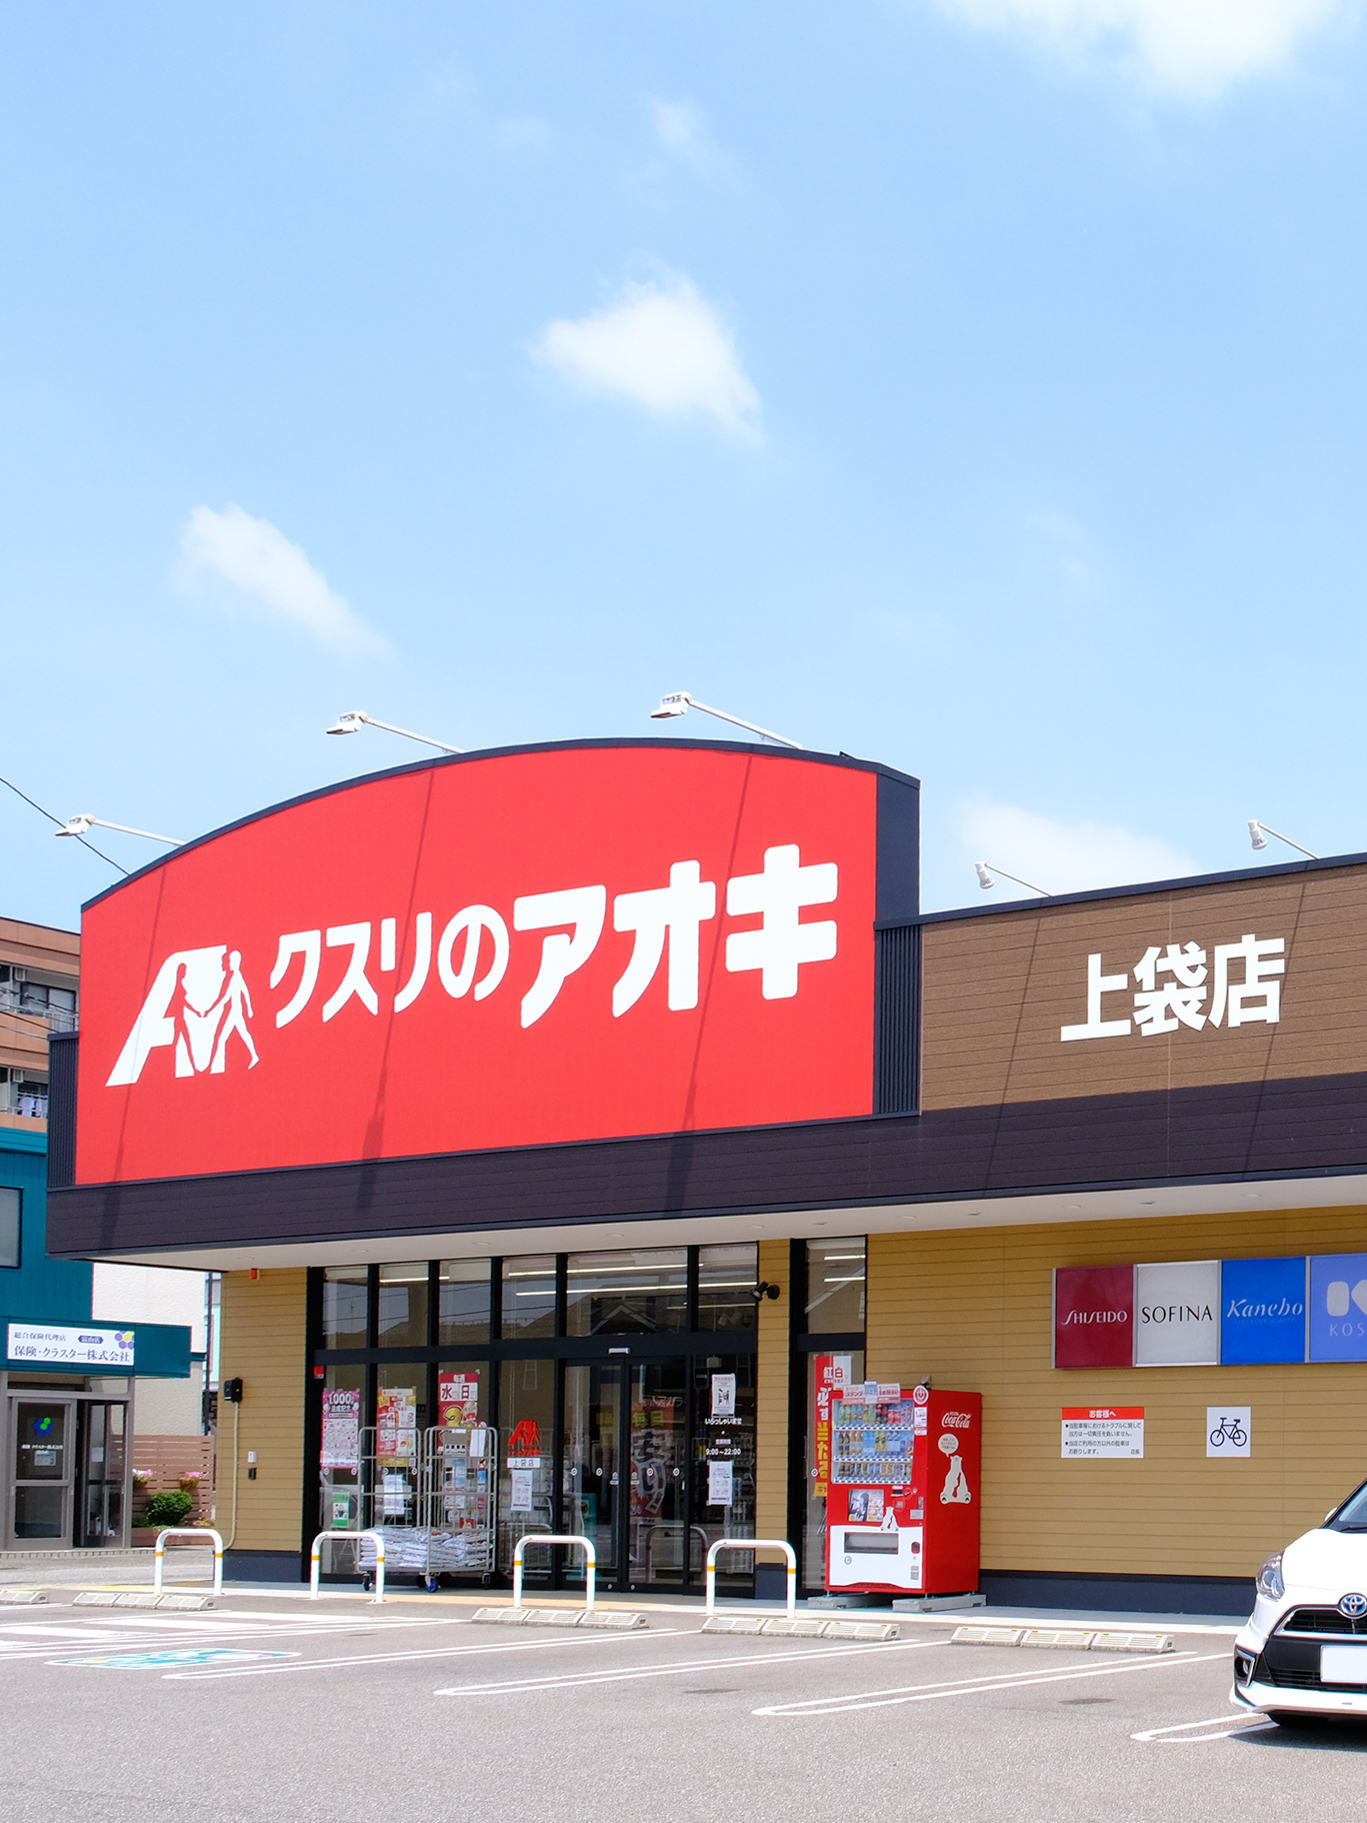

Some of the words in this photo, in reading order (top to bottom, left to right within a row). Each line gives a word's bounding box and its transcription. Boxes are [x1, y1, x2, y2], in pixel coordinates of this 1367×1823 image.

[270, 843, 839, 1029] クスリのアオキ
[1060, 934, 1286, 1042] 上袋店
[1141, 1305, 1213, 1324] SOFINA
[1226, 1297, 1304, 1318] Kanebo
[1061, 1309, 1128, 1326] SHISEIDO
[442, 1385, 452, 1399] 水
[461, 1385, 470, 1399] 日
[1089, 1409, 1117, 1418] お客様へ
